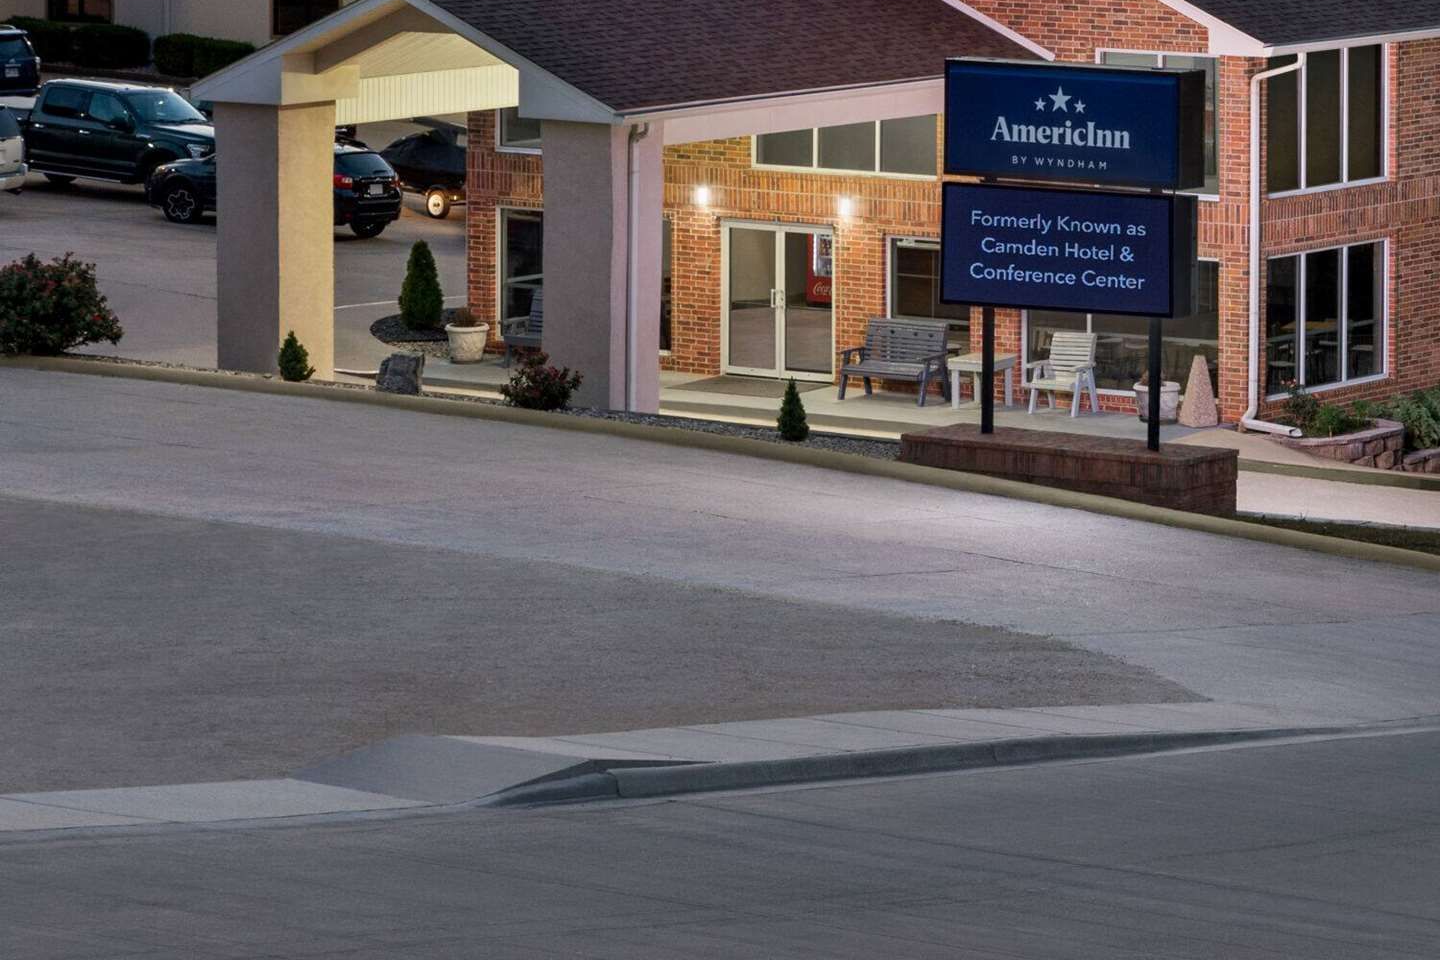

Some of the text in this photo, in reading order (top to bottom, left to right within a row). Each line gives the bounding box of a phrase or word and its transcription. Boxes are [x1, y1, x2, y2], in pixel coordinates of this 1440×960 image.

[990, 116, 1130, 149] AmericInn
[1012, 155, 1107, 170] BY WYNDHAM
[971, 210, 1146, 237] Formerly Known as
[981, 237, 1134, 262] Camden Hotel &
[969, 262, 1145, 289] Conference Center
